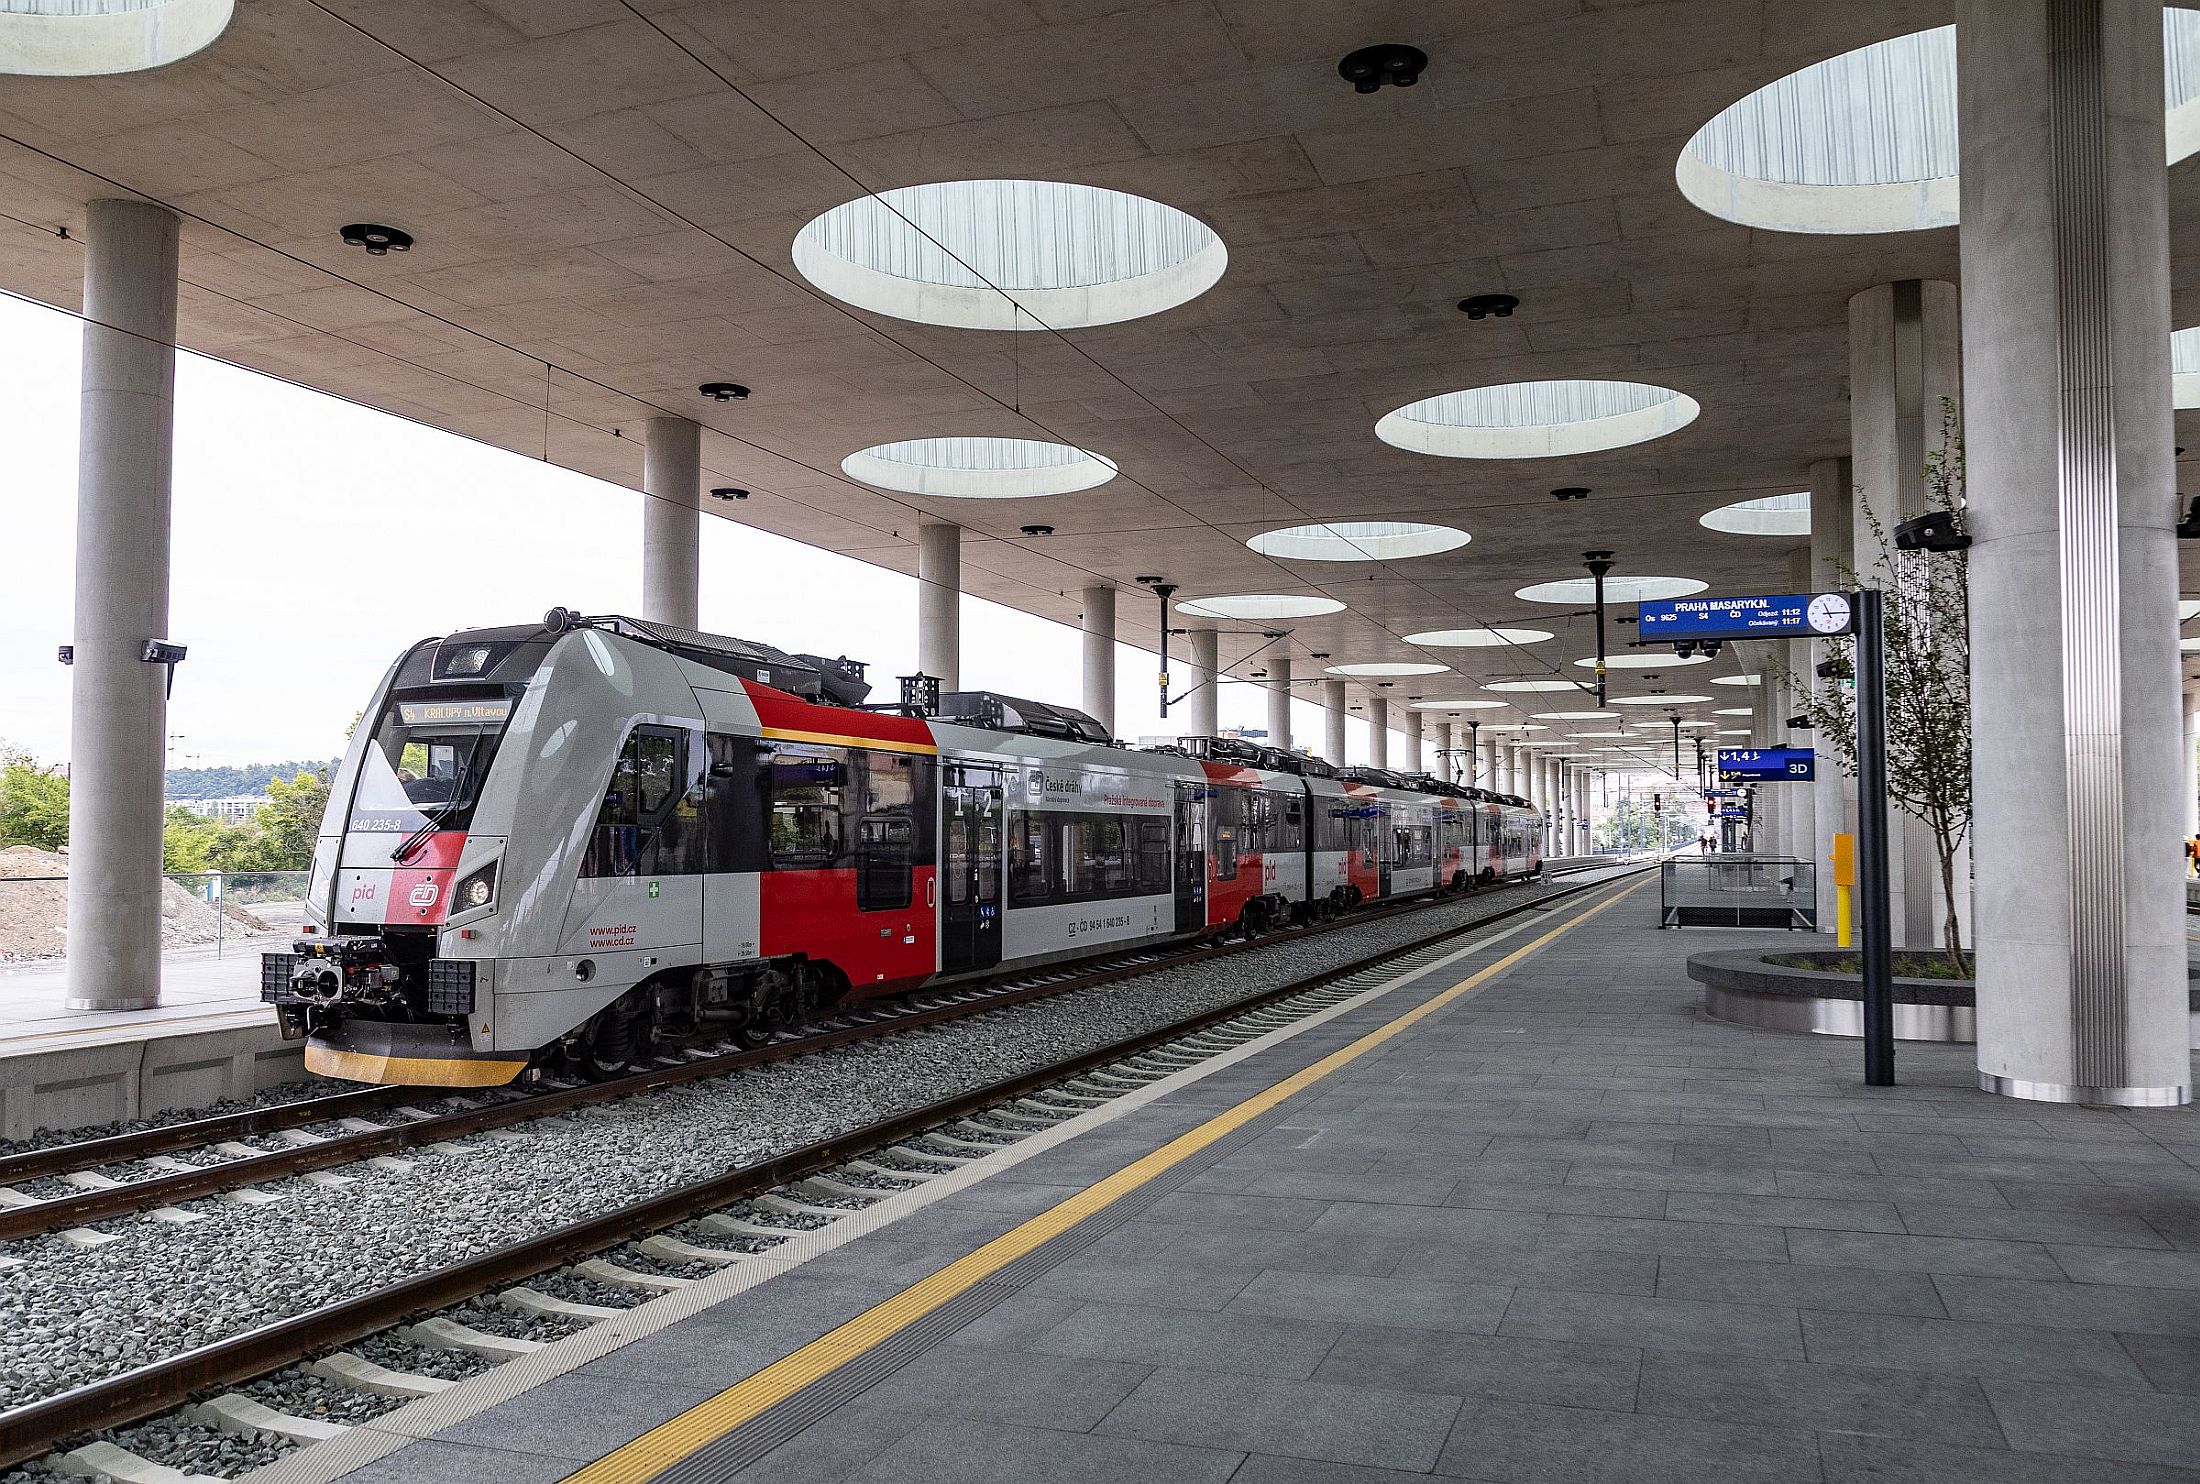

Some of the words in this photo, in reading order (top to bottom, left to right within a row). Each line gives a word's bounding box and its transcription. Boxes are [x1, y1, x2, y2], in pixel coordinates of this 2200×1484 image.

[1675, 602, 1708, 613] PRAHA
[1645, 614, 1656, 622] Os
[1698, 612, 1709, 620] S4
[1729, 609, 1741, 618] ČD
[1781, 608, 1801, 616] 11:12
[1781, 617, 1801, 626] 11:17
[424, 707, 462, 719] KRALUPY
[1789, 764, 1808, 774] 3D
[1045, 775, 1064, 792] České
[1065, 779, 1082, 797] dráhy
[983, 790, 992, 818] 2
[352, 819, 369, 831] 640
[370, 819, 401, 831] 235-8
[352, 884, 376, 904] pid
[590, 923, 637, 936] www.pid.cz
[1068, 922, 1076, 934] CZ
[1079, 918, 1088, 932] ČD
[590, 936, 635, 948] www.cd.cz
